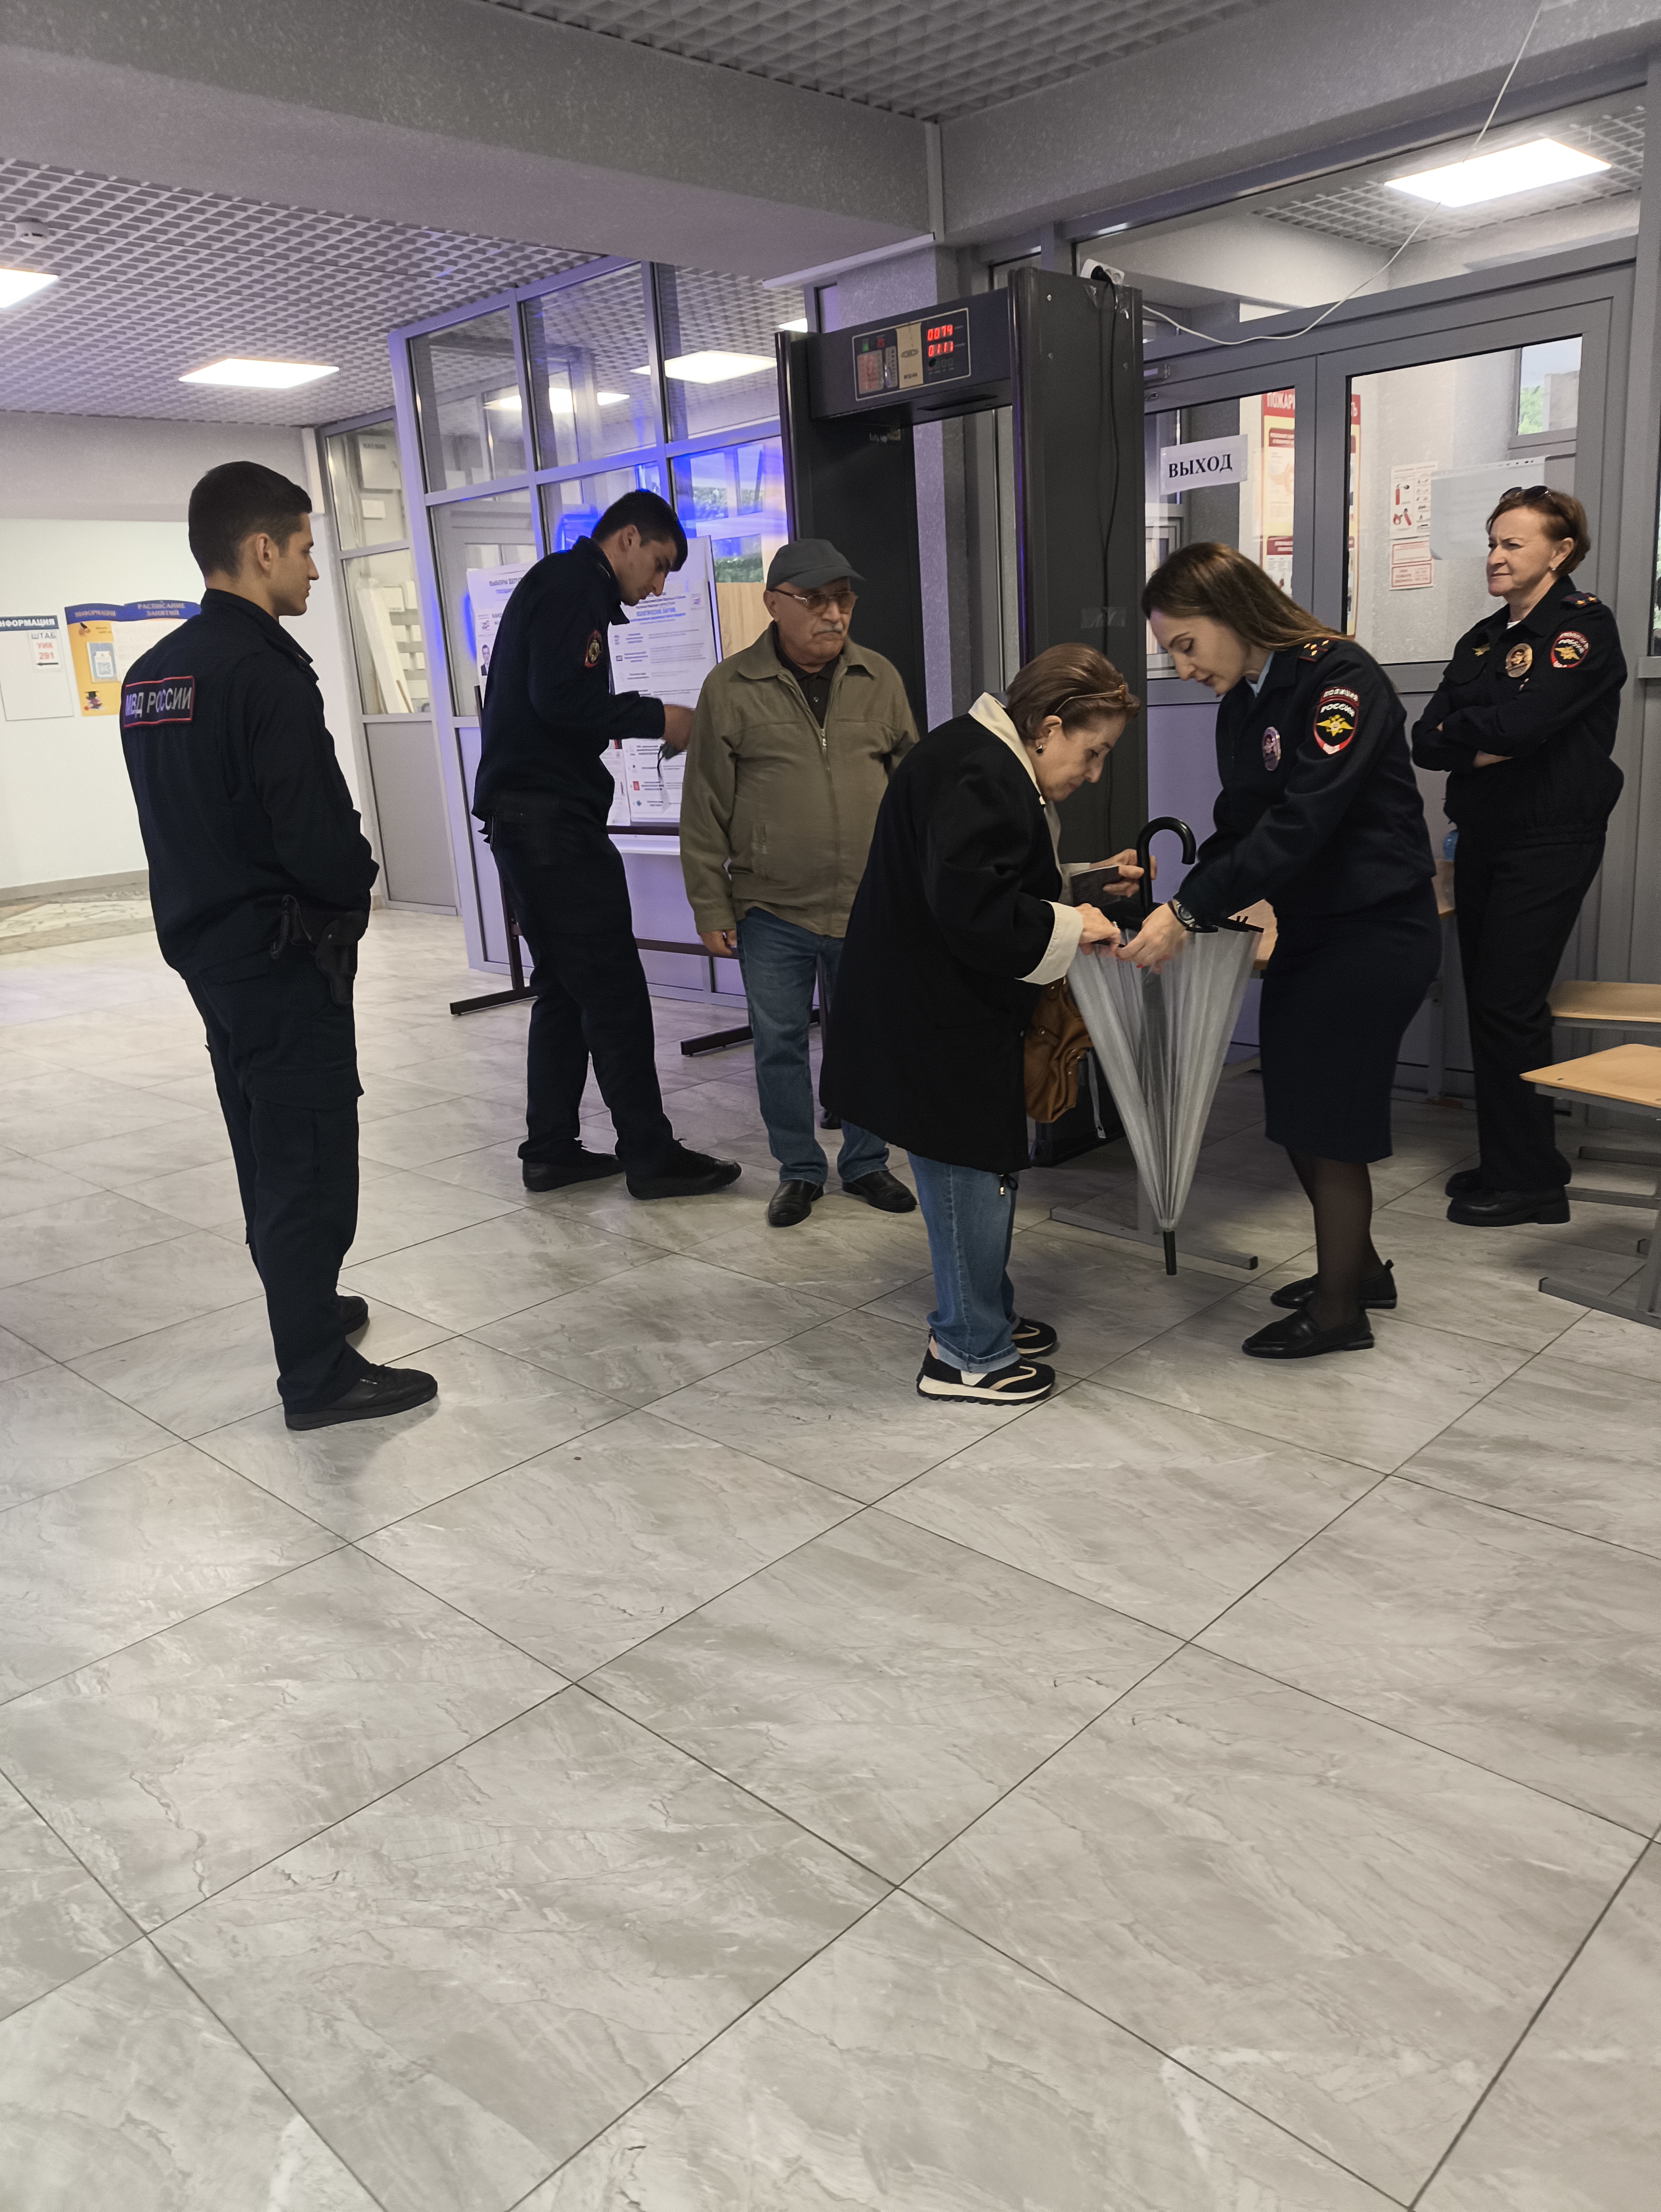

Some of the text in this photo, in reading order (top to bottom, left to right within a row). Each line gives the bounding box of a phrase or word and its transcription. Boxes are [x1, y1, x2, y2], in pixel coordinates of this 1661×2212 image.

[1168, 453, 1233, 478] ВЫХОД
[125, 687, 191, 718] МВД РОССИИ
